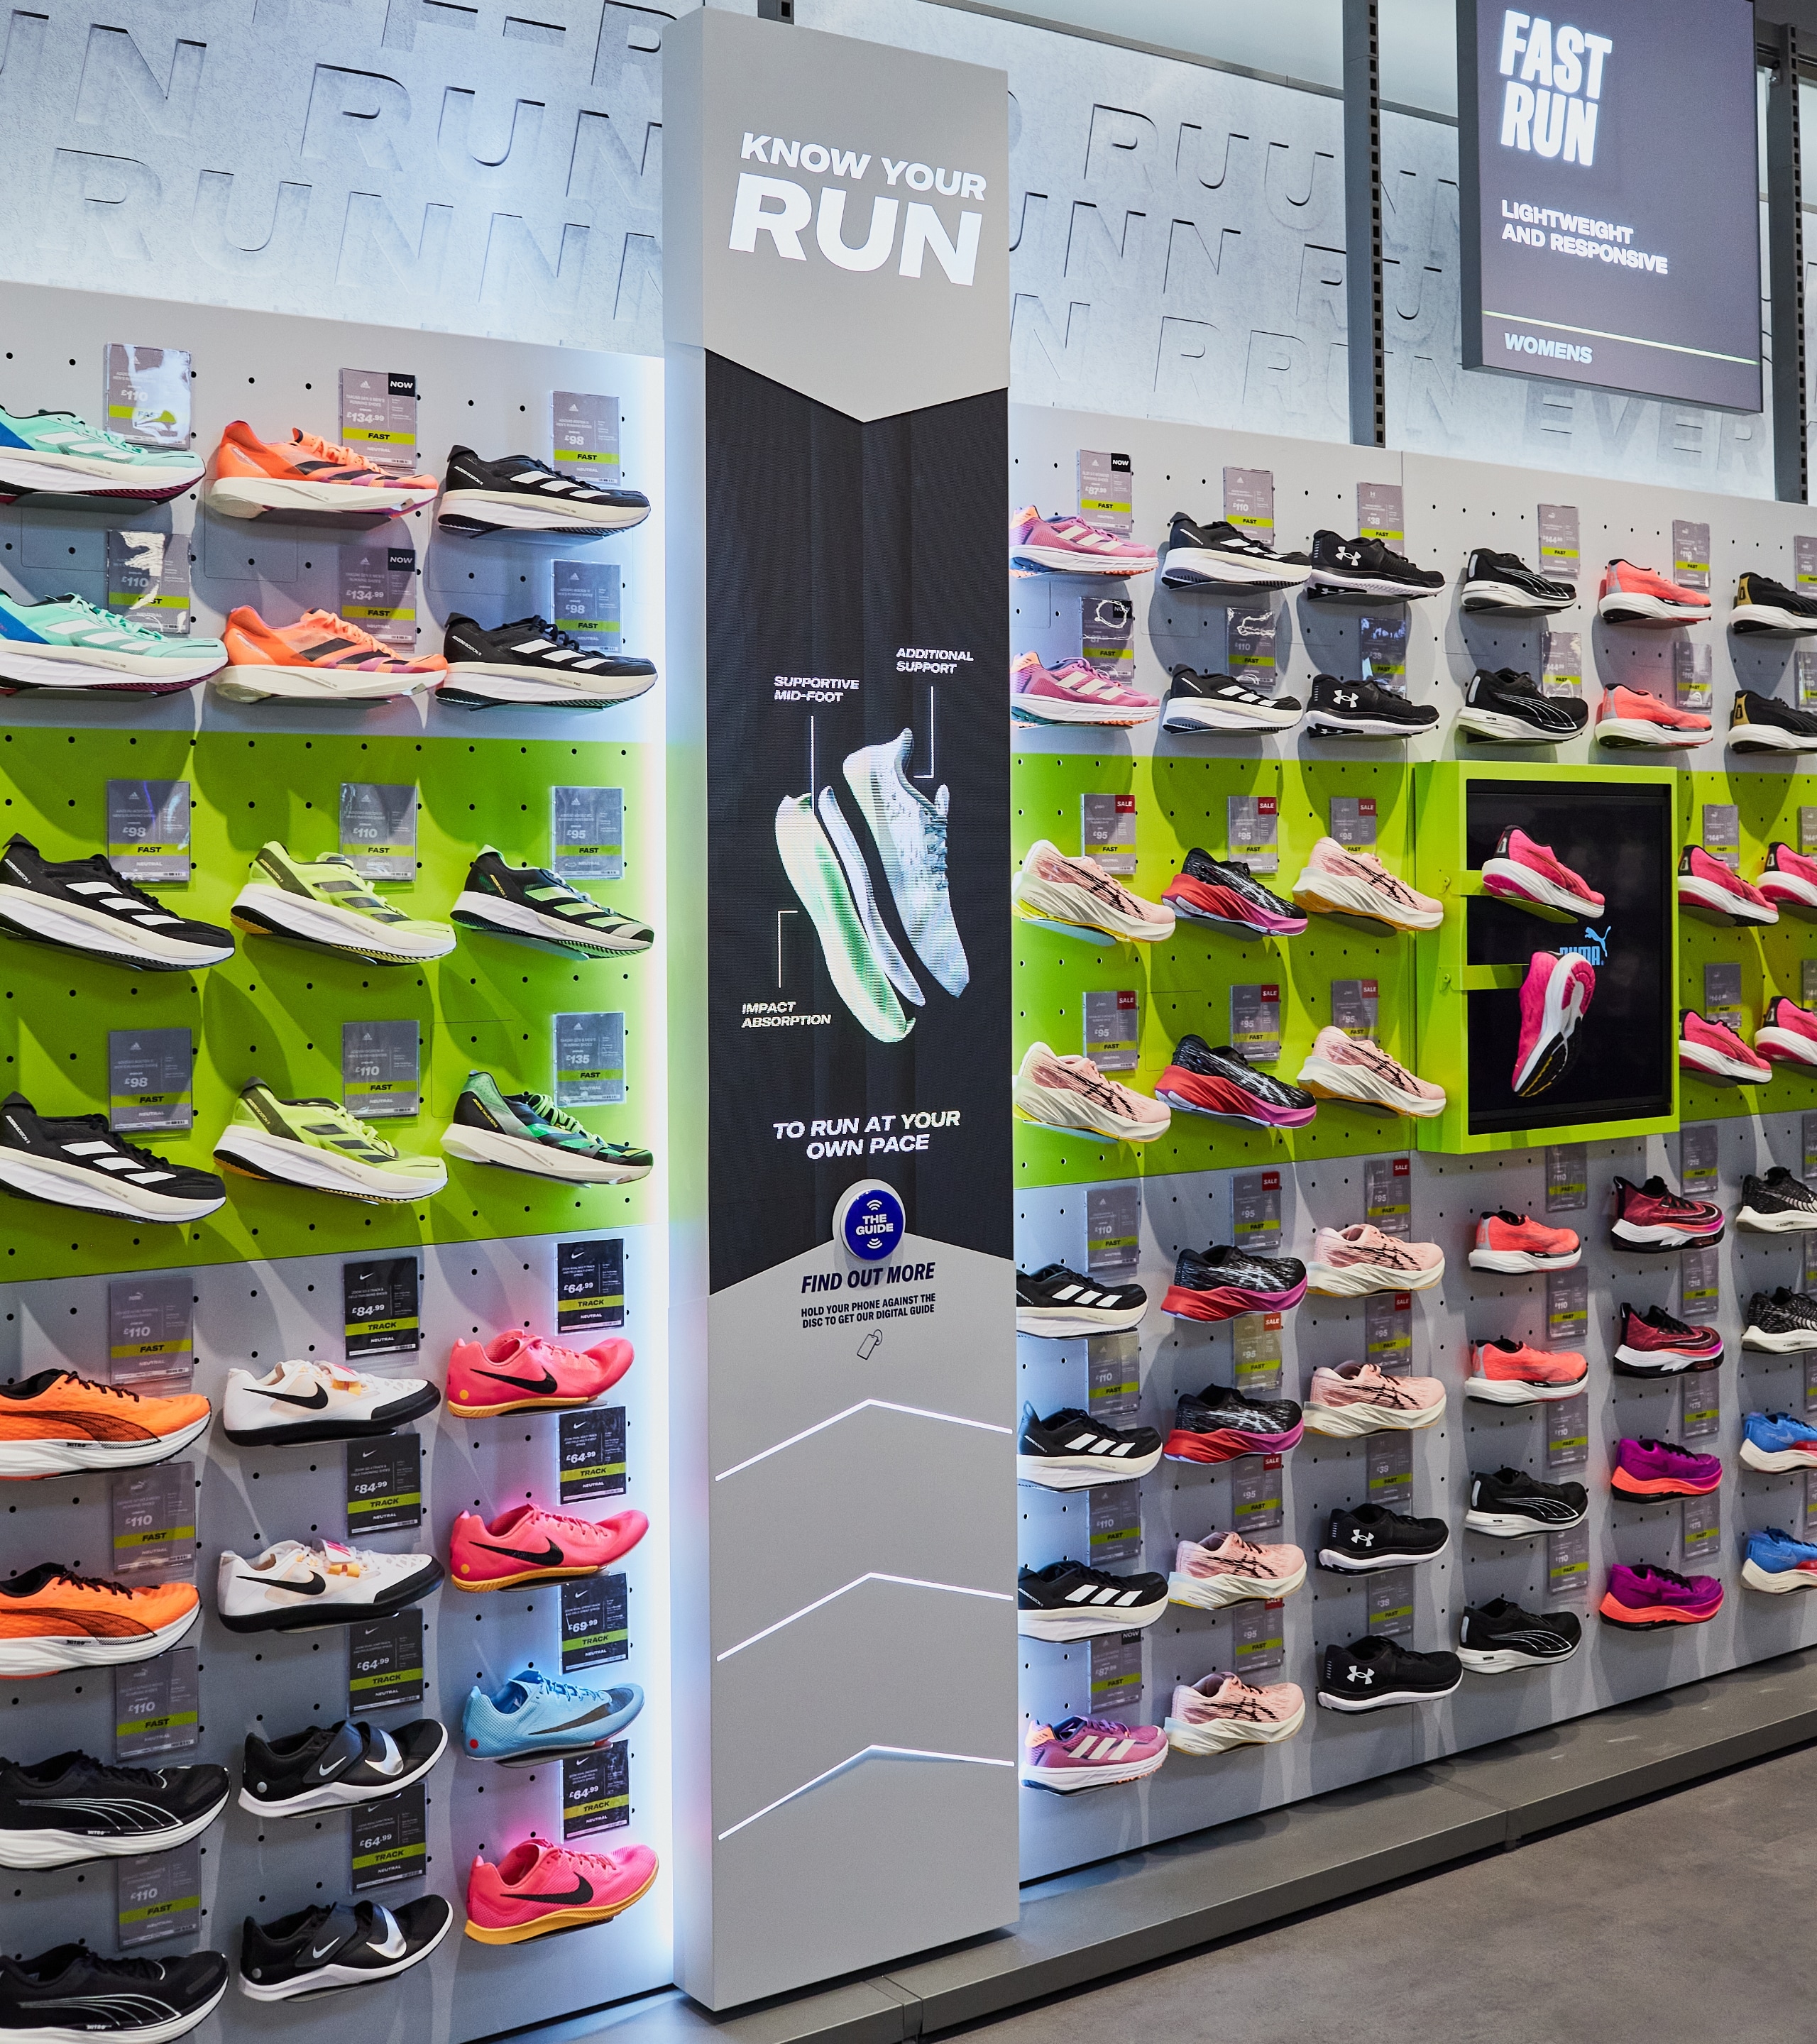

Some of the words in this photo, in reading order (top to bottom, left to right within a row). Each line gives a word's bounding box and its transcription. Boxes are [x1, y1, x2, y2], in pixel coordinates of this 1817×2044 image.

[1499, 9, 1613, 100] FAST
[1500, 79, 1598, 167] RUN
[740, 131, 871, 180] KNOW
[881, 157, 987, 201] YOUR
[1501, 199, 1633, 244] LIGHTWEIGHT
[729, 172, 982, 286] RUN
[1501, 224, 1545, 247] AND
[1550, 231, 1668, 275] RESPONSIVE
[1505, 332, 1593, 364] WOMENS
[390, 380, 413, 389] NOW
[346, 412, 385, 424] £134.99
[564, 434, 584, 446] £98
[1368, 517, 1380, 525] £38
[121, 576, 149, 588] £110
[346, 590, 384, 600] £134.99
[565, 604, 586, 615] £98
[896, 647, 975, 661] ADDITIONAL
[896, 661, 957, 674] SUPPORT
[774, 676, 860, 690] SUPPORTIVE
[774, 689, 844, 703] MID-FOOT
[122, 827, 146, 837] £98
[353, 828, 378, 838] £110
[566, 830, 586, 839] £95
[1093, 831, 1108, 840] £95
[1238, 832, 1251, 840] £95
[742, 1001, 796, 1015] IMPACT
[741, 1014, 832, 1028] ABSORPTION
[1241, 1020, 1254, 1028] £95
[1342, 1015, 1355, 1023] £95
[1094, 1029, 1109, 1038] £95
[566, 1055, 590, 1065] £135
[356, 1066, 380, 1077] £110
[124, 1077, 148, 1088] £98
[773, 1121, 806, 1139] TO
[810, 1118, 860, 1136] RUN
[864, 1115, 896, 1133] AT
[901, 1110, 961, 1130] YOUR
[806, 1139, 864, 1160] OWN
[869, 1133, 931, 1154] PACE
[862, 1214, 887, 1224] THE
[855, 1223, 894, 1236] GUIDE
[1094, 1226, 1112, 1234] £110
[801, 1273, 842, 1293] FIND
[847, 1268, 883, 1289] OUT
[886, 1262, 935, 1284] MORE
[564, 1282, 593, 1294] £64.99
[578, 1299, 604, 1307] TRACK
[801, 1306, 824, 1317] HOLD
[826, 1304, 850, 1314] YOUR
[851, 1300, 880, 1312] PHONE
[882, 1295, 918, 1308] AGAINST
[921, 1293, 935, 1302] THE
[351, 1304, 385, 1317] £84.99
[802, 1317, 823, 1329] DISC
[825, 1316, 836, 1326] TO
[838, 1314, 854, 1324] GET
[856, 1312, 874, 1322] OUR
[876, 1307, 908, 1319] DIGITAL
[910, 1304, 935, 1315] GUIDE
[123, 1326, 150, 1338] £110
[368, 1322, 397, 1331] TRACK
[140, 1344, 165, 1353] FAST
[1243, 1350, 1256, 1358] £95
[1095, 1373, 1112, 1383] £110
[566, 1451, 596, 1463] £64.99
[580, 1467, 607, 1477] TRACK
[1377, 1465, 1389, 1474] £38
[354, 1480, 388, 1494] £84.99
[1244, 1490, 1256, 1499] £95
[370, 1498, 400, 1508] TRACK
[125, 1515, 153, 1526] £110
[1097, 1519, 1114, 1529] £110
[142, 1532, 168, 1542] FAST
[568, 1619, 598, 1632] £69.99
[582, 1634, 608, 1645] TRACK
[1251, 1642, 1266, 1650] FAST
[357, 1657, 390, 1671] £64.99
[372, 1674, 402, 1685] TRACK
[1107, 1678, 1124, 1686] FAST
[128, 1702, 155, 1714] £110
[145, 1718, 170, 1728] FAST
[569, 1786, 599, 1800] £64.99
[583, 1801, 610, 1812] TRACK
[586, 1815, 608, 1823] NEUTRAL
[359, 1834, 392, 1849] £64.99
[375, 1850, 405, 1862] TRACK
[378, 1864, 402, 1874] NEUTRAL
[130, 1888, 158, 1901] £110
[147, 1903, 172, 1915] FAST
